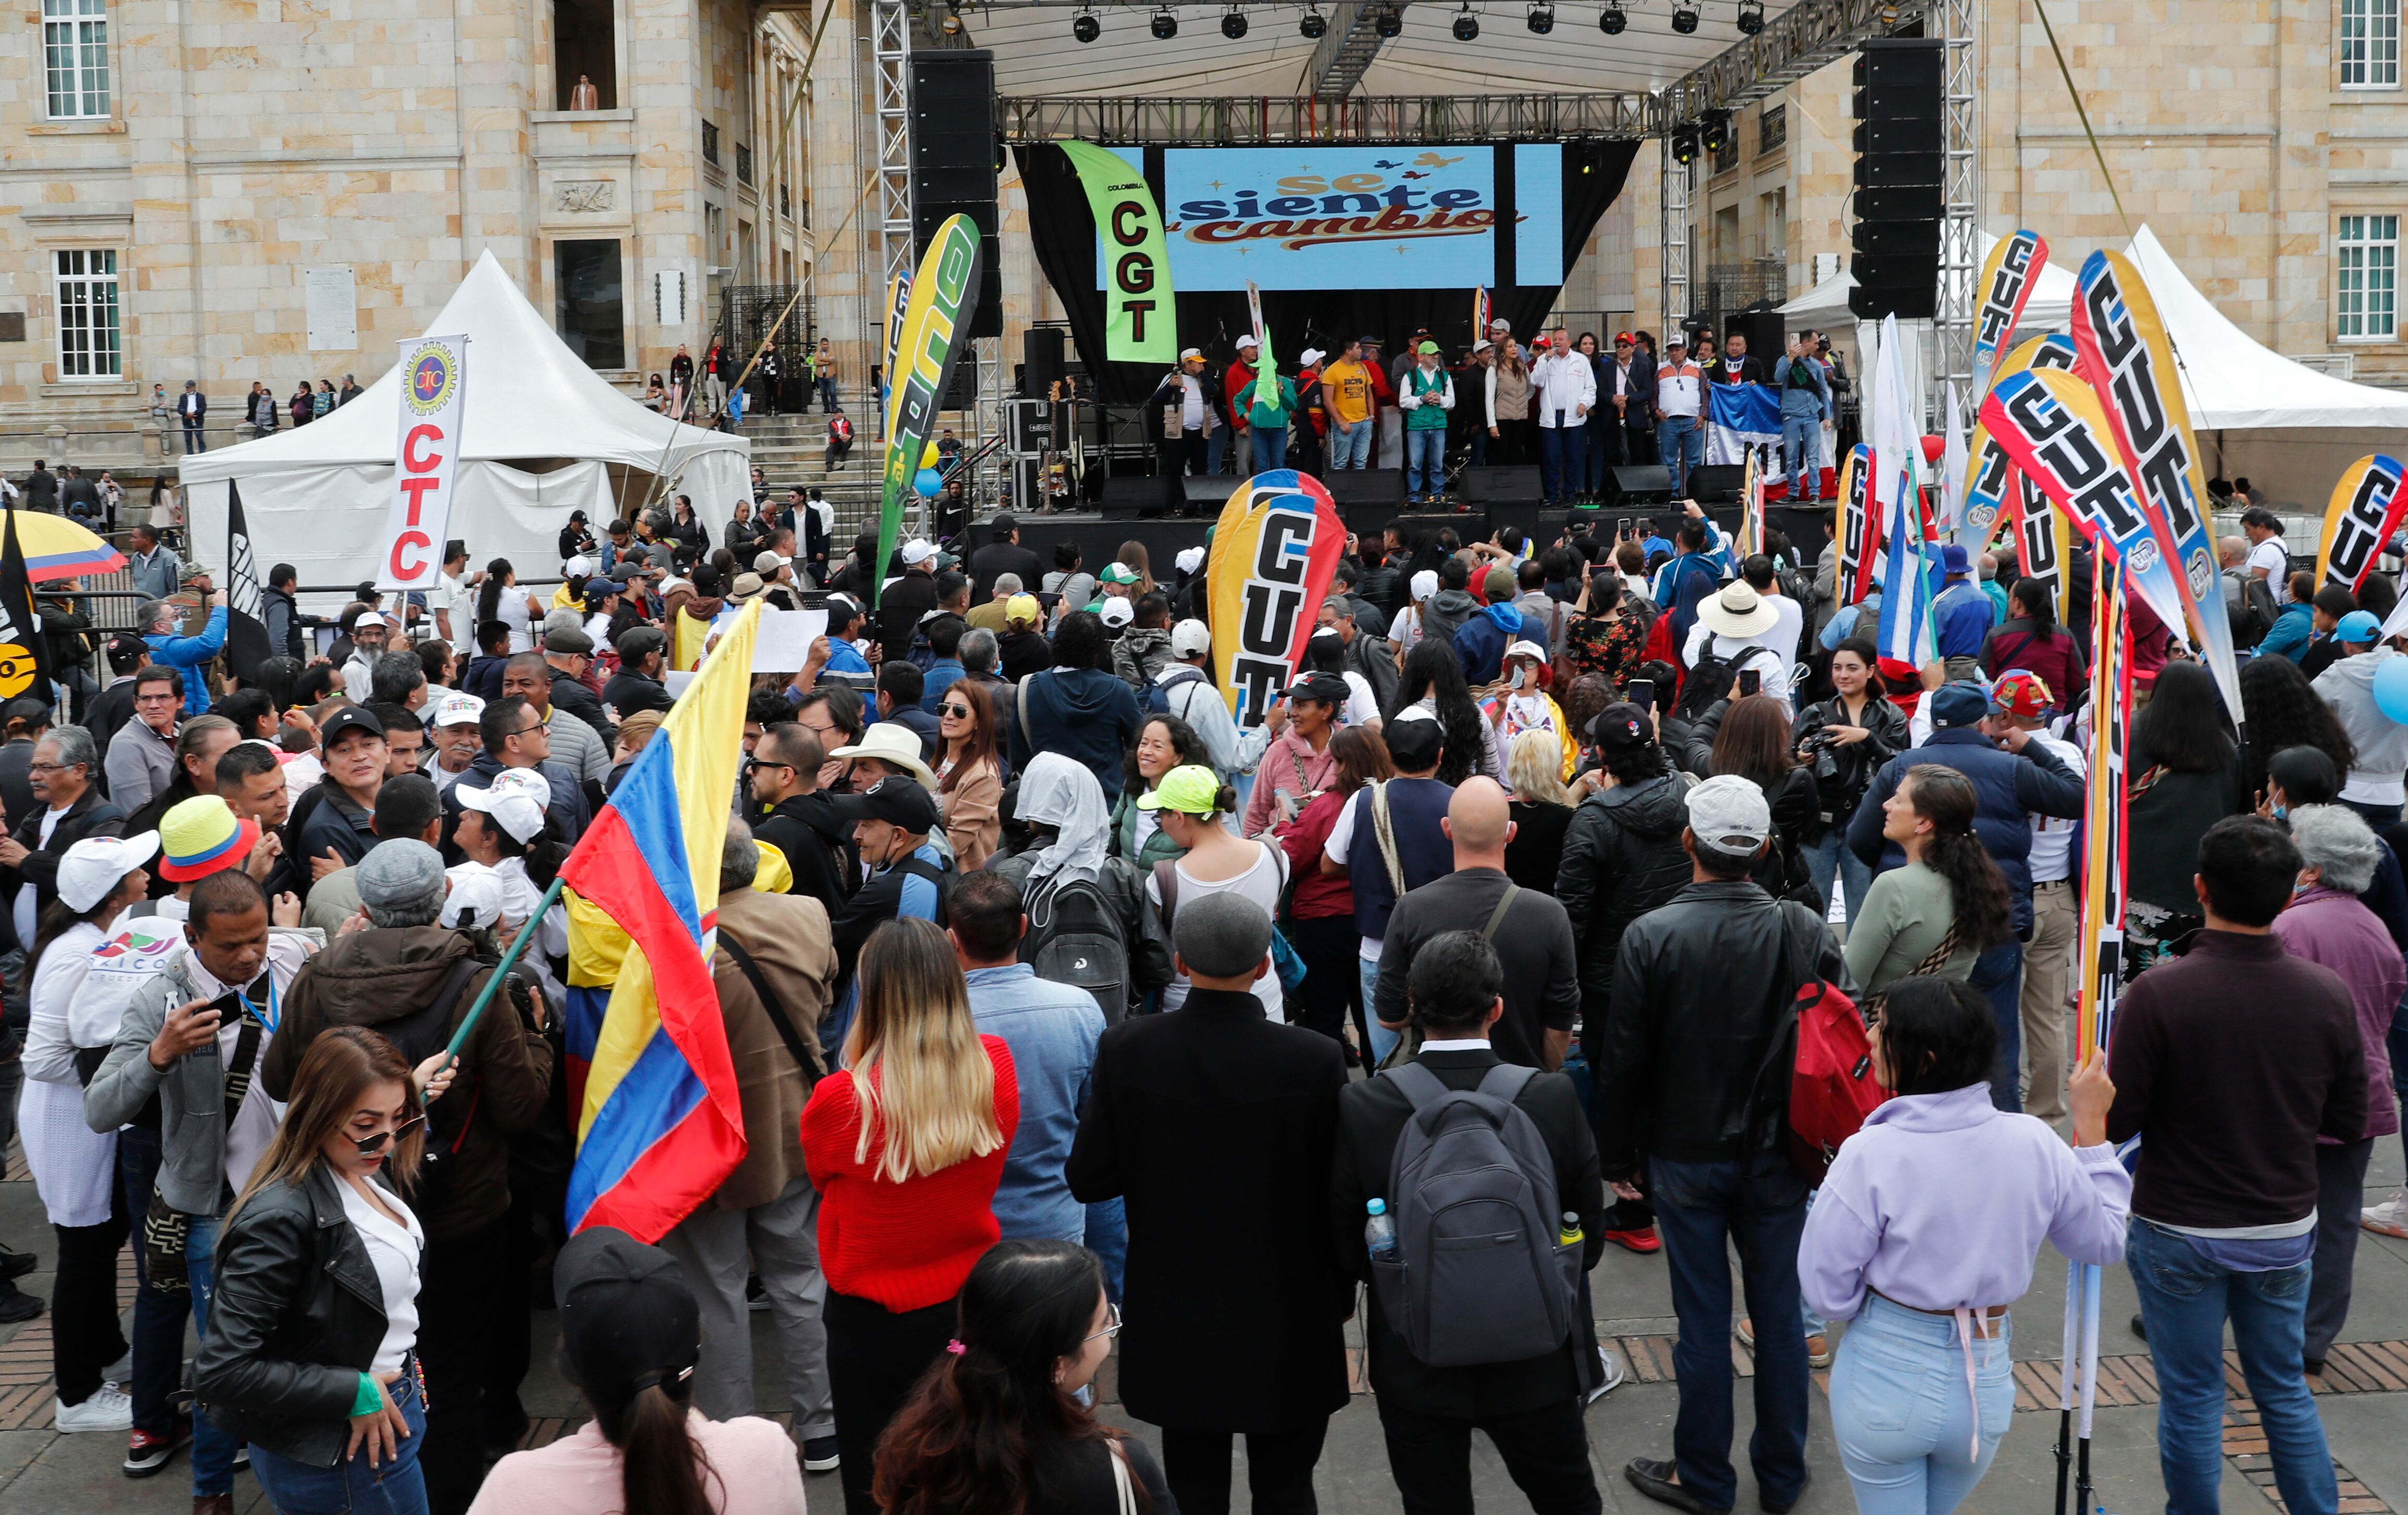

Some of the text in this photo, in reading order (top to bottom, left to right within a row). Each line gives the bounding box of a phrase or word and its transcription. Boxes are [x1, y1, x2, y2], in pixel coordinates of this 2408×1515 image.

[1108, 183, 1143, 191] COLOMBIA
[1179, 185, 1482, 221] siente
[1184, 204, 1528, 246] cambio
[1276, 174, 1386, 196] se
[1112, 201, 1156, 342] CGT
[1979, 235, 2036, 346] CUT
[415, 371, 443, 389] CTC
[2084, 261, 2200, 549] CUT
[390, 423, 444, 581] CTC
[2005, 376, 2148, 544] CUT
[1840, 454, 1869, 608] CUT
[2320, 464, 2402, 592] CU
[1229, 508, 1318, 729] CUT
